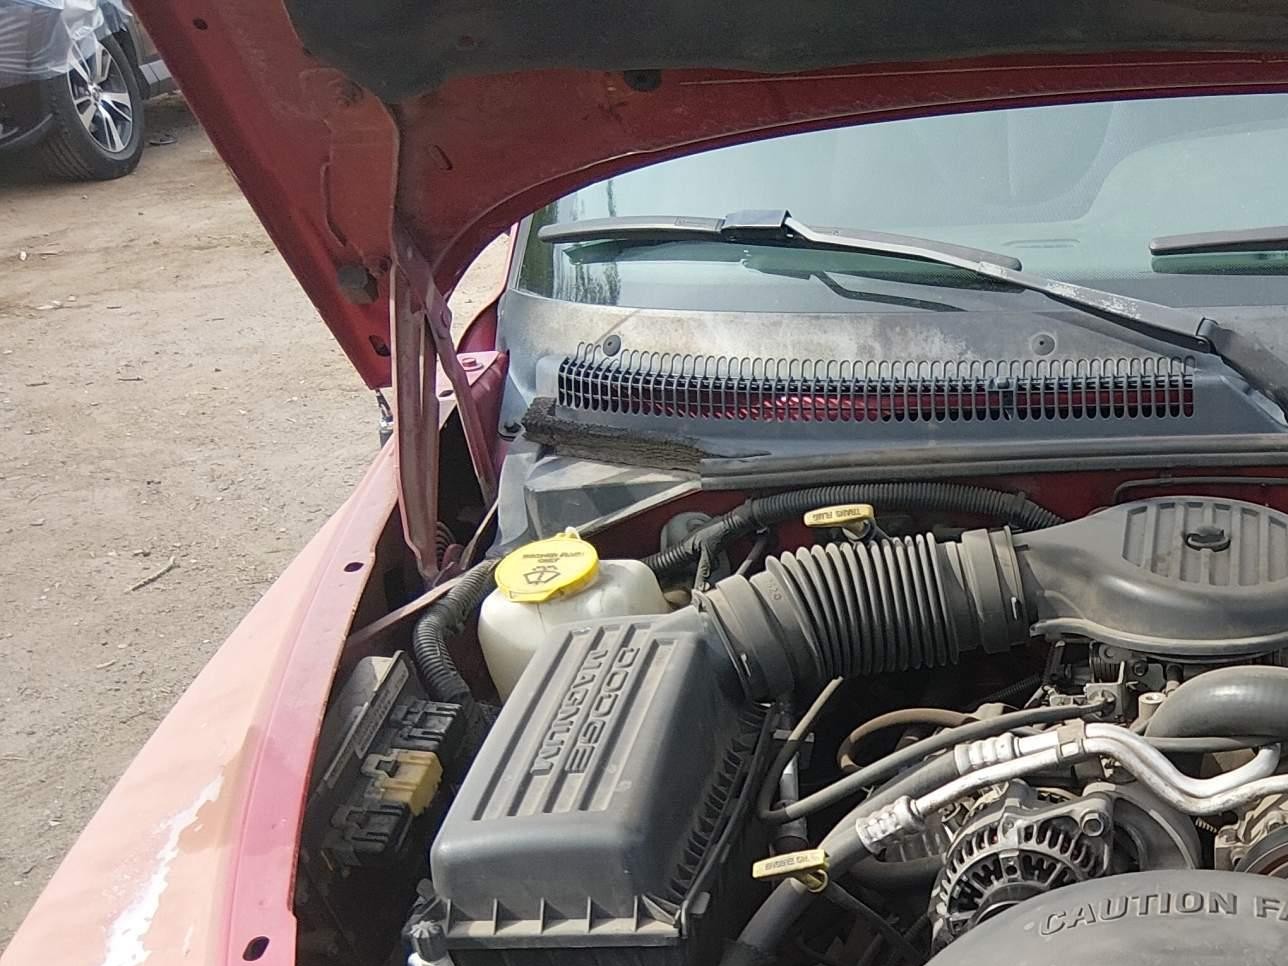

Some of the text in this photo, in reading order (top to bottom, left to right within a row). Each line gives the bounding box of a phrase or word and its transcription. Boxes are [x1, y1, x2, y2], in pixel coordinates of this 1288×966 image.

[530, 649, 609, 777] MAGNUM
[565, 647, 641, 774] DODGE
[1039, 890, 1238, 936] CAUTION
